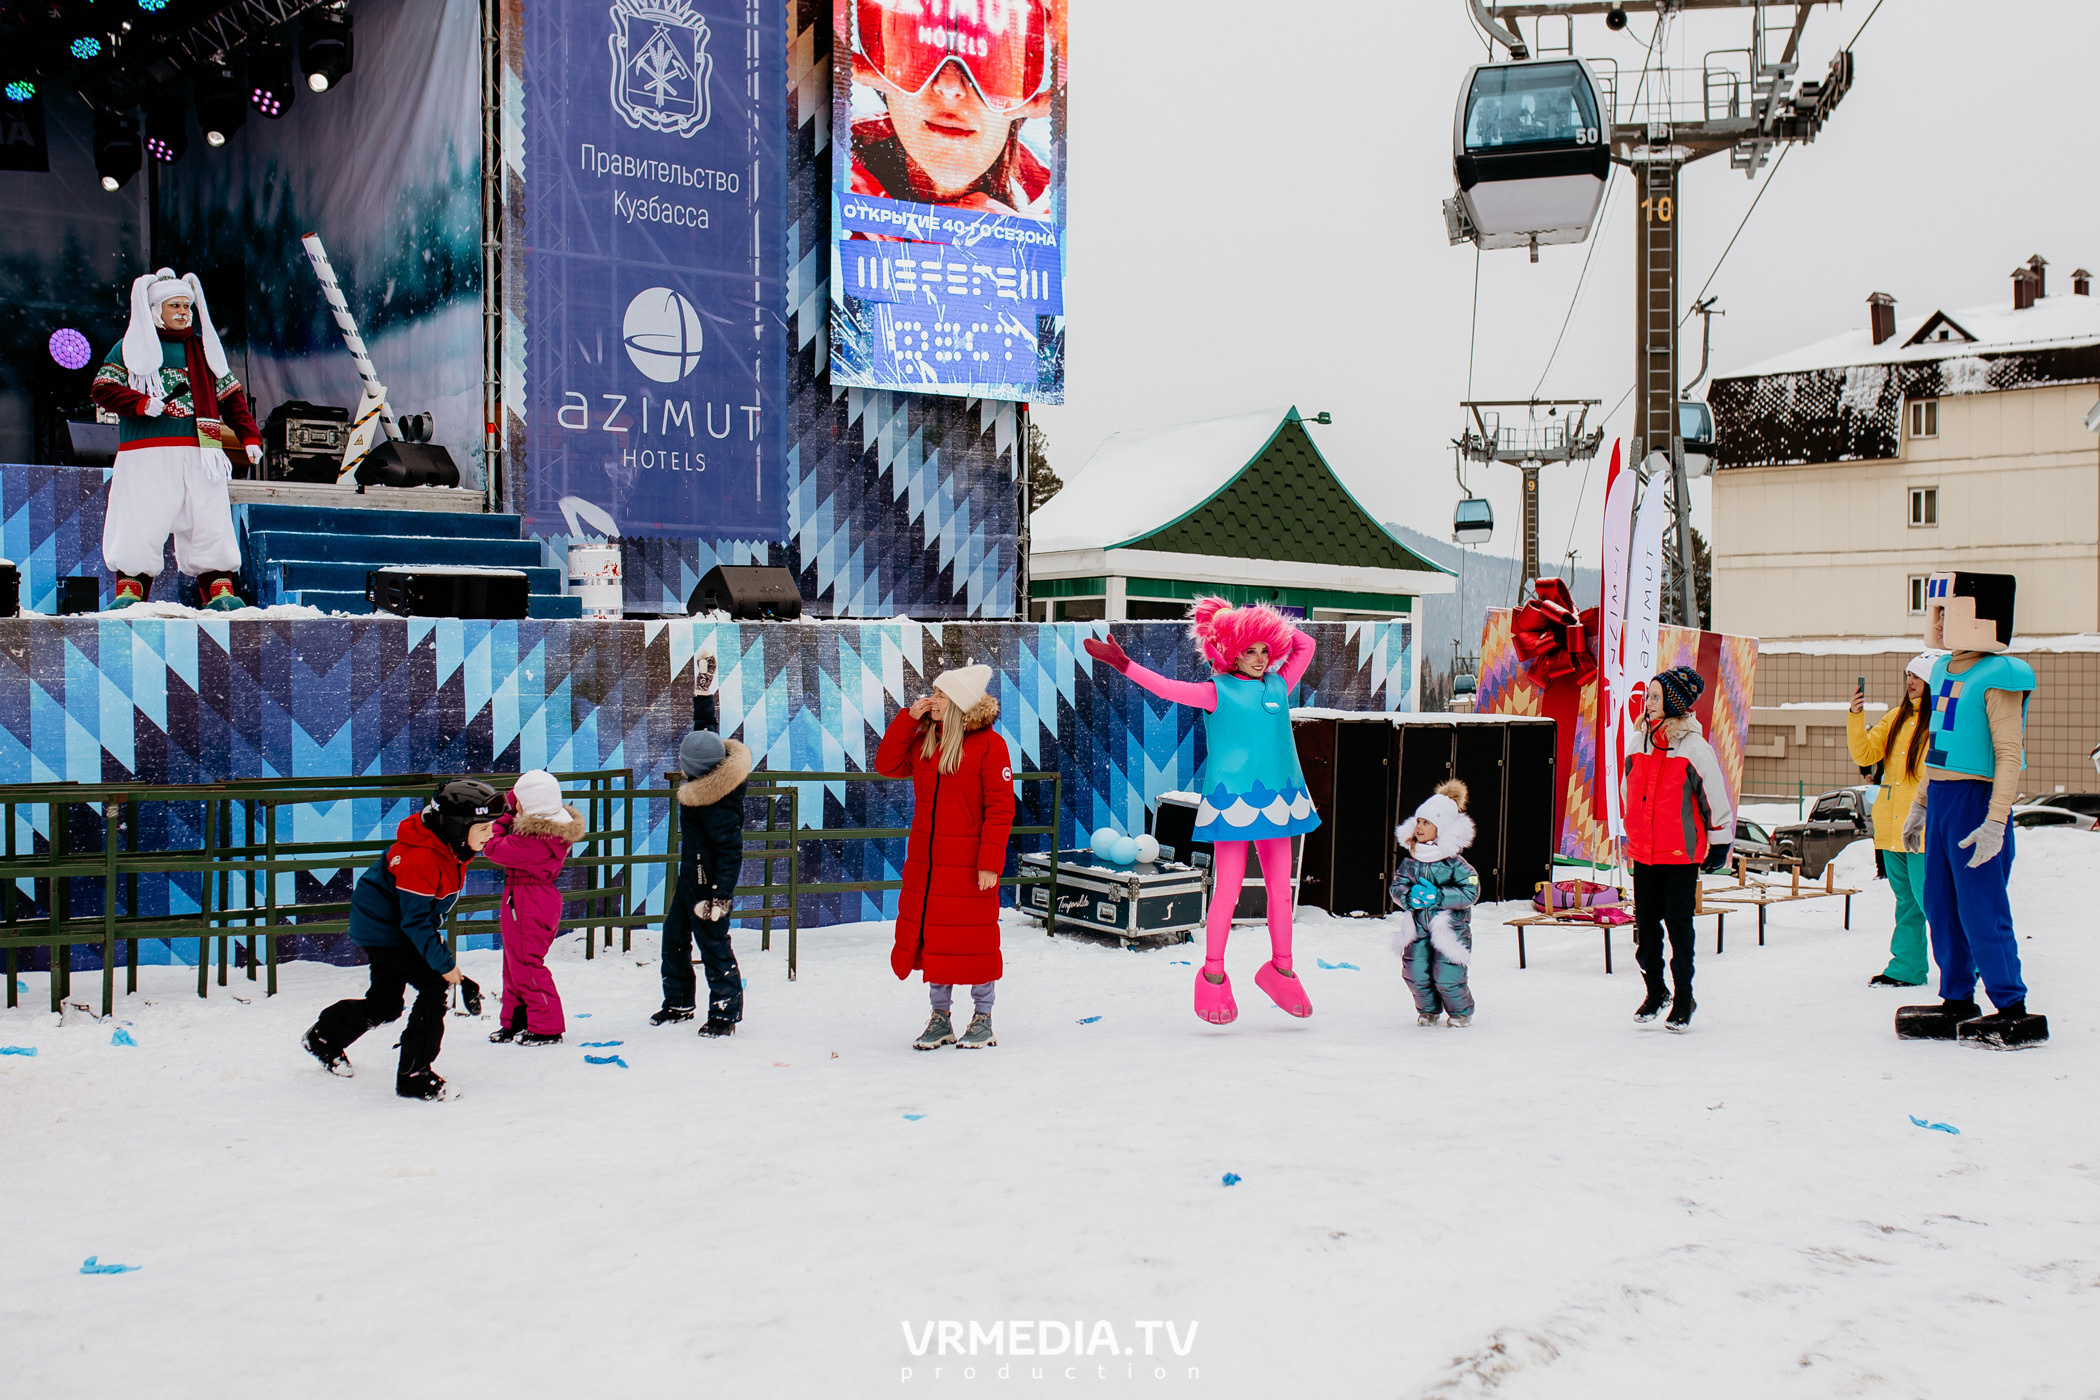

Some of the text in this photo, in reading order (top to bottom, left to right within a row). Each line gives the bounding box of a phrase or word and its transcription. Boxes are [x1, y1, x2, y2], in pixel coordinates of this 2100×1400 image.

[918, 25, 988, 57] HOTELS
[1575, 127, 1599, 145] 50
[581, 143, 740, 193] Правительство
[614, 189, 709, 229] Кузбасса
[1641, 196, 1675, 222] 10
[843, 204, 941, 231] ОТКРЫТИЕ
[993, 225, 1058, 248] СЕЗОНА
[623, 448, 706, 472] HOTELS
[1528, 480, 1536, 492] 9
